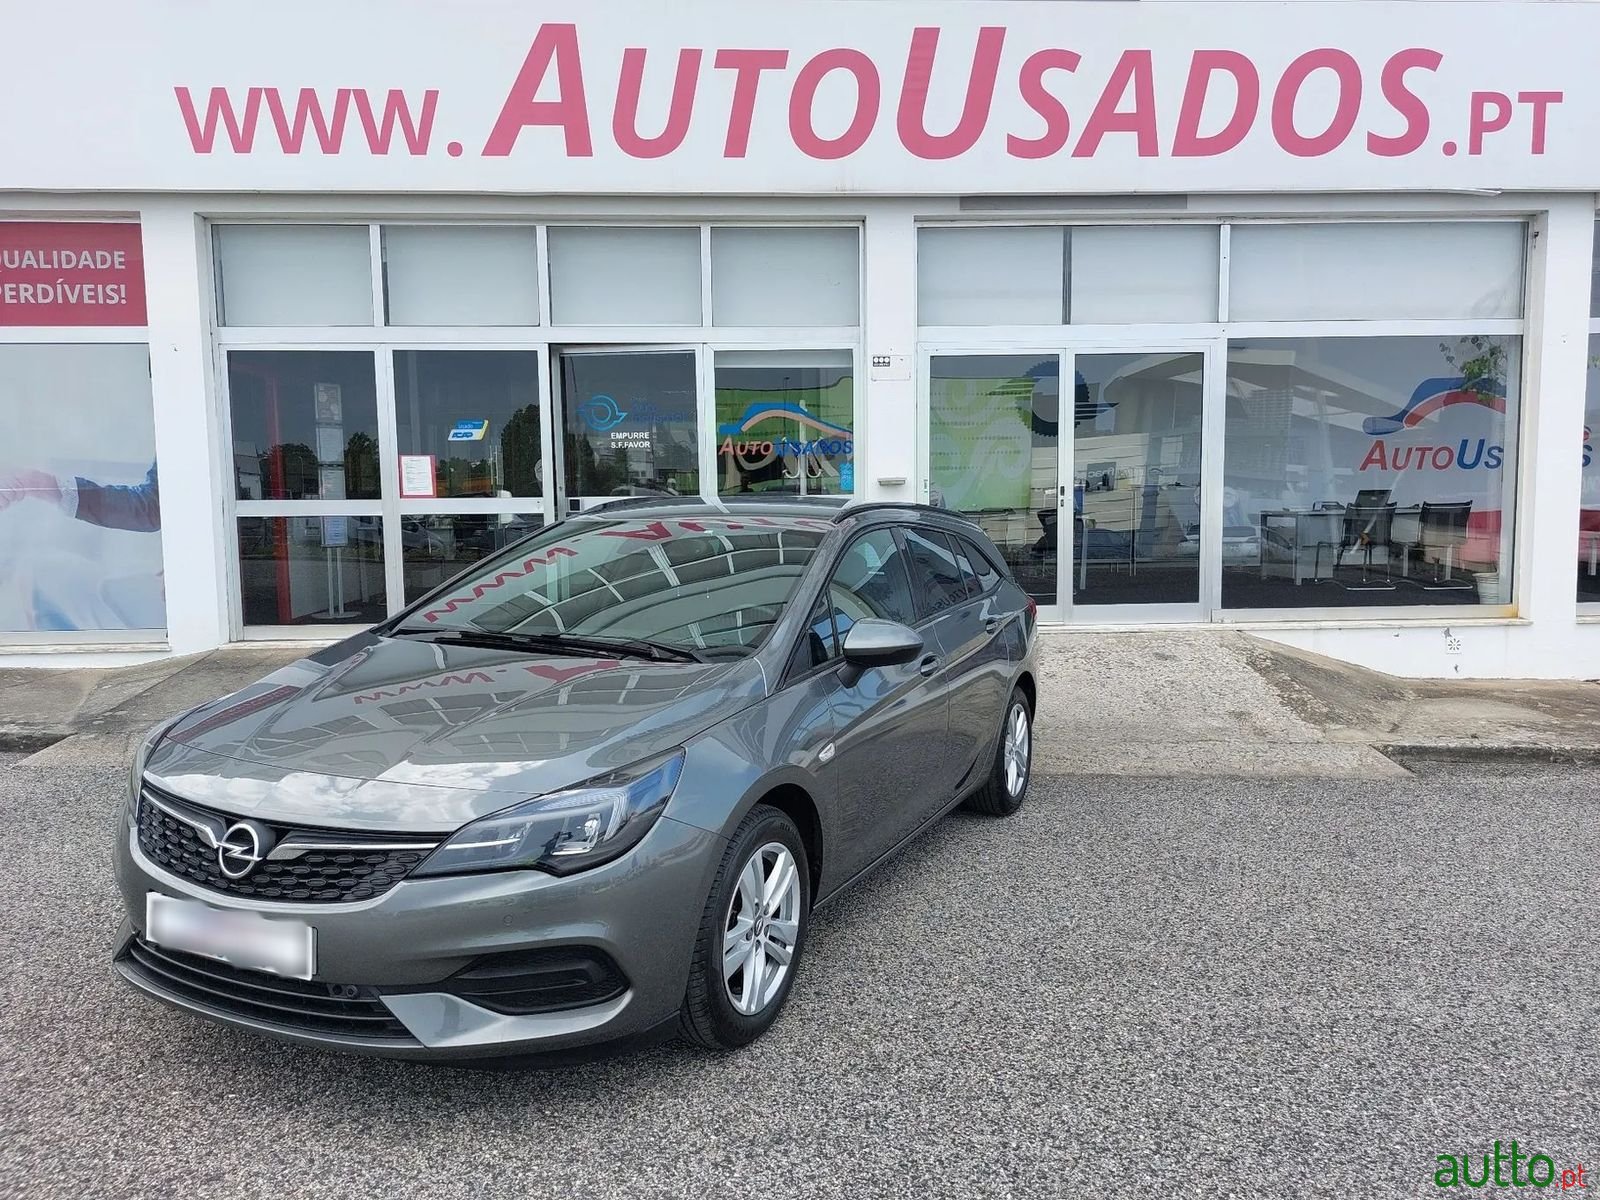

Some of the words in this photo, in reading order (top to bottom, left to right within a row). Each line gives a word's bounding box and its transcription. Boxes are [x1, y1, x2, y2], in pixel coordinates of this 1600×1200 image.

[0, 250, 126, 272] UALIDADE
[0, 278, 127, 305] ERDÍVEIS!
[610, 431, 650, 440] EMPURRE
[610, 440, 651, 449] S.F.FAVOR
